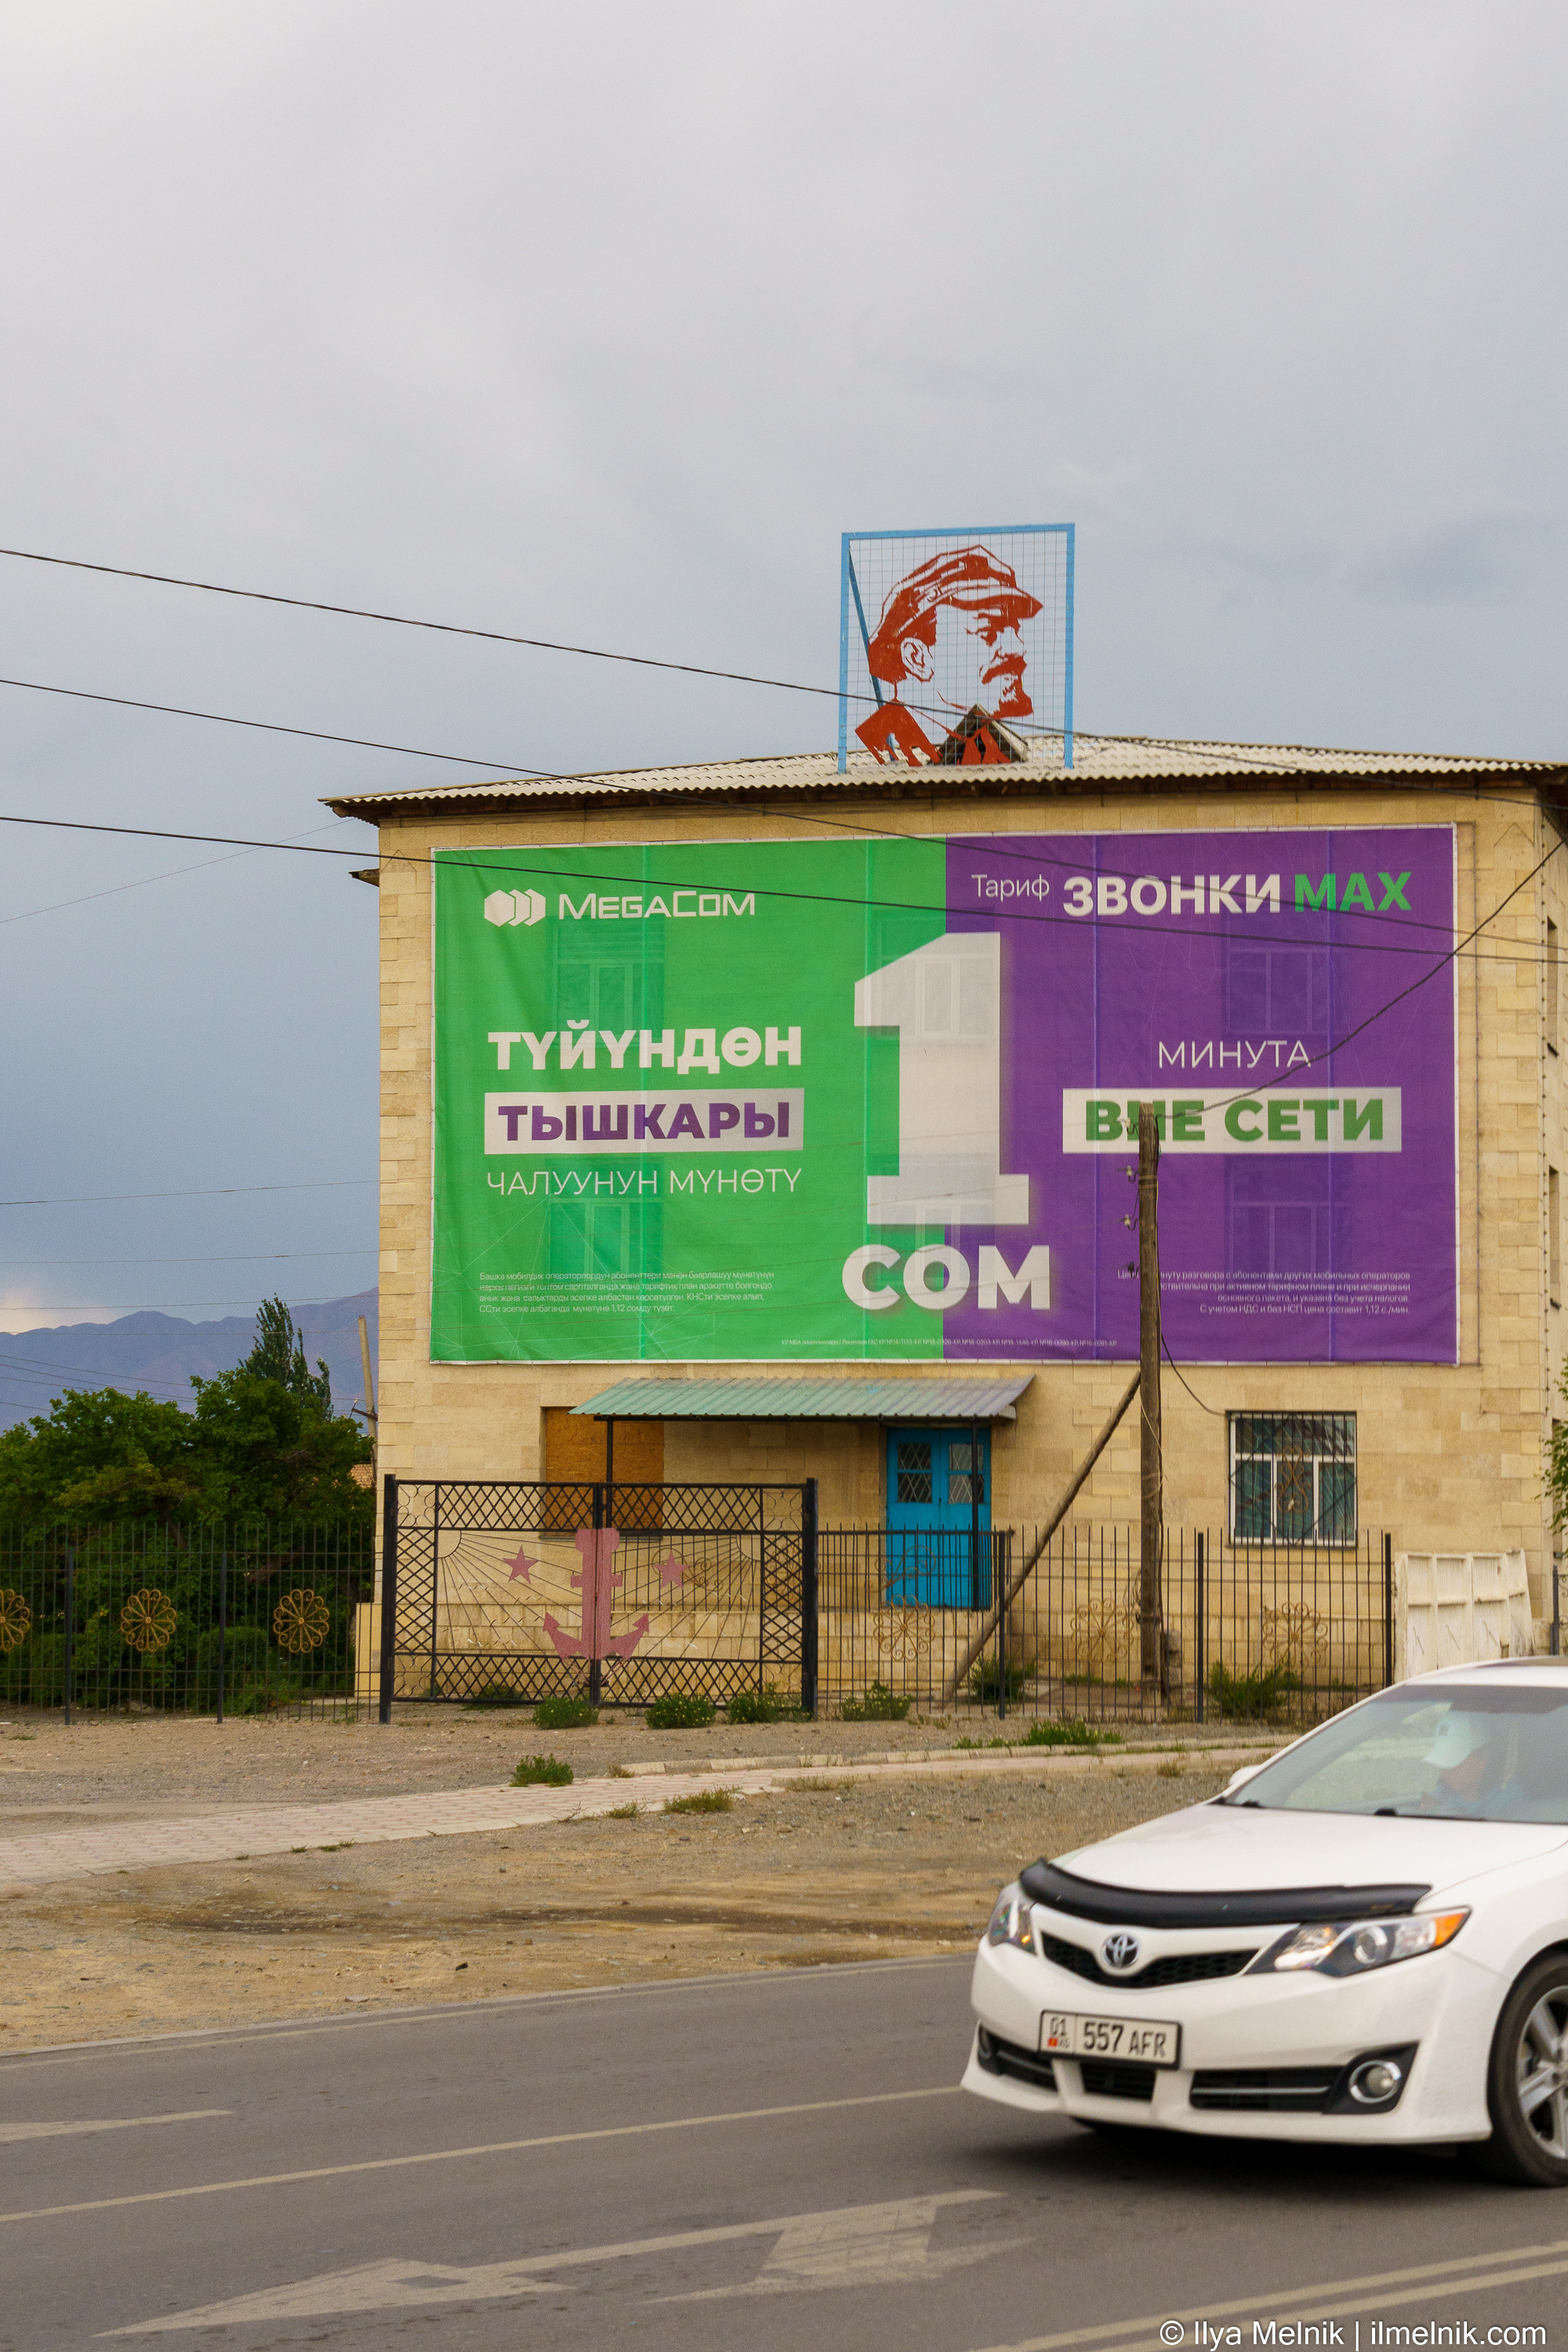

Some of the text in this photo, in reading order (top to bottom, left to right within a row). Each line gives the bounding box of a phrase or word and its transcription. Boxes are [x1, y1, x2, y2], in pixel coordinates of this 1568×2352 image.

[971, 873, 1051, 902] Тариф
[1062, 873, 1282, 916] ЗВОНКИ
[487, 1019, 802, 1075] ТҮЙҮНДӨН
[1159, 1040, 1312, 1069] МИНУТА
[854, 931, 1029, 1225] 1
[498, 1102, 790, 1142] ТЫШКАРЫ
[1085, 1099, 1384, 1142] ВНЕ СЕТИ
[487, 1168, 802, 1196] ЧАЛУУНУН МҮНӨТҮ
[480, 1272, 505, 1281] Башка
[506, 1272, 544, 1281] мобилдик
[546, 1272, 611, 1282] операторлордун
[1283, 1271, 1312, 1281] других
[1361, 1271, 1410, 1280] операторов
[641, 1282, 677, 1291] тарифтик
[1209, 1283, 1225, 1292] при
[1343, 1283, 1359, 1292] при
[522, 1294, 569, 1303] салыктарды
[598, 1293, 635, 1302] албастан
[714, 1293, 742, 1301] эсепке
[742, 1293, 765, 1301] алып,
[1334, 1292, 1348, 1303] без
[530, 1304, 570, 1314] албаганда
[611, 1304, 626, 1313] 1,12
[626, 1305, 652, 1314] сомду
[1267, 1303, 1282, 1314] без
[1365, 1304, 1380, 1315] 1,12
[1050, 2016, 1167, 2057] 01 557 AFR
